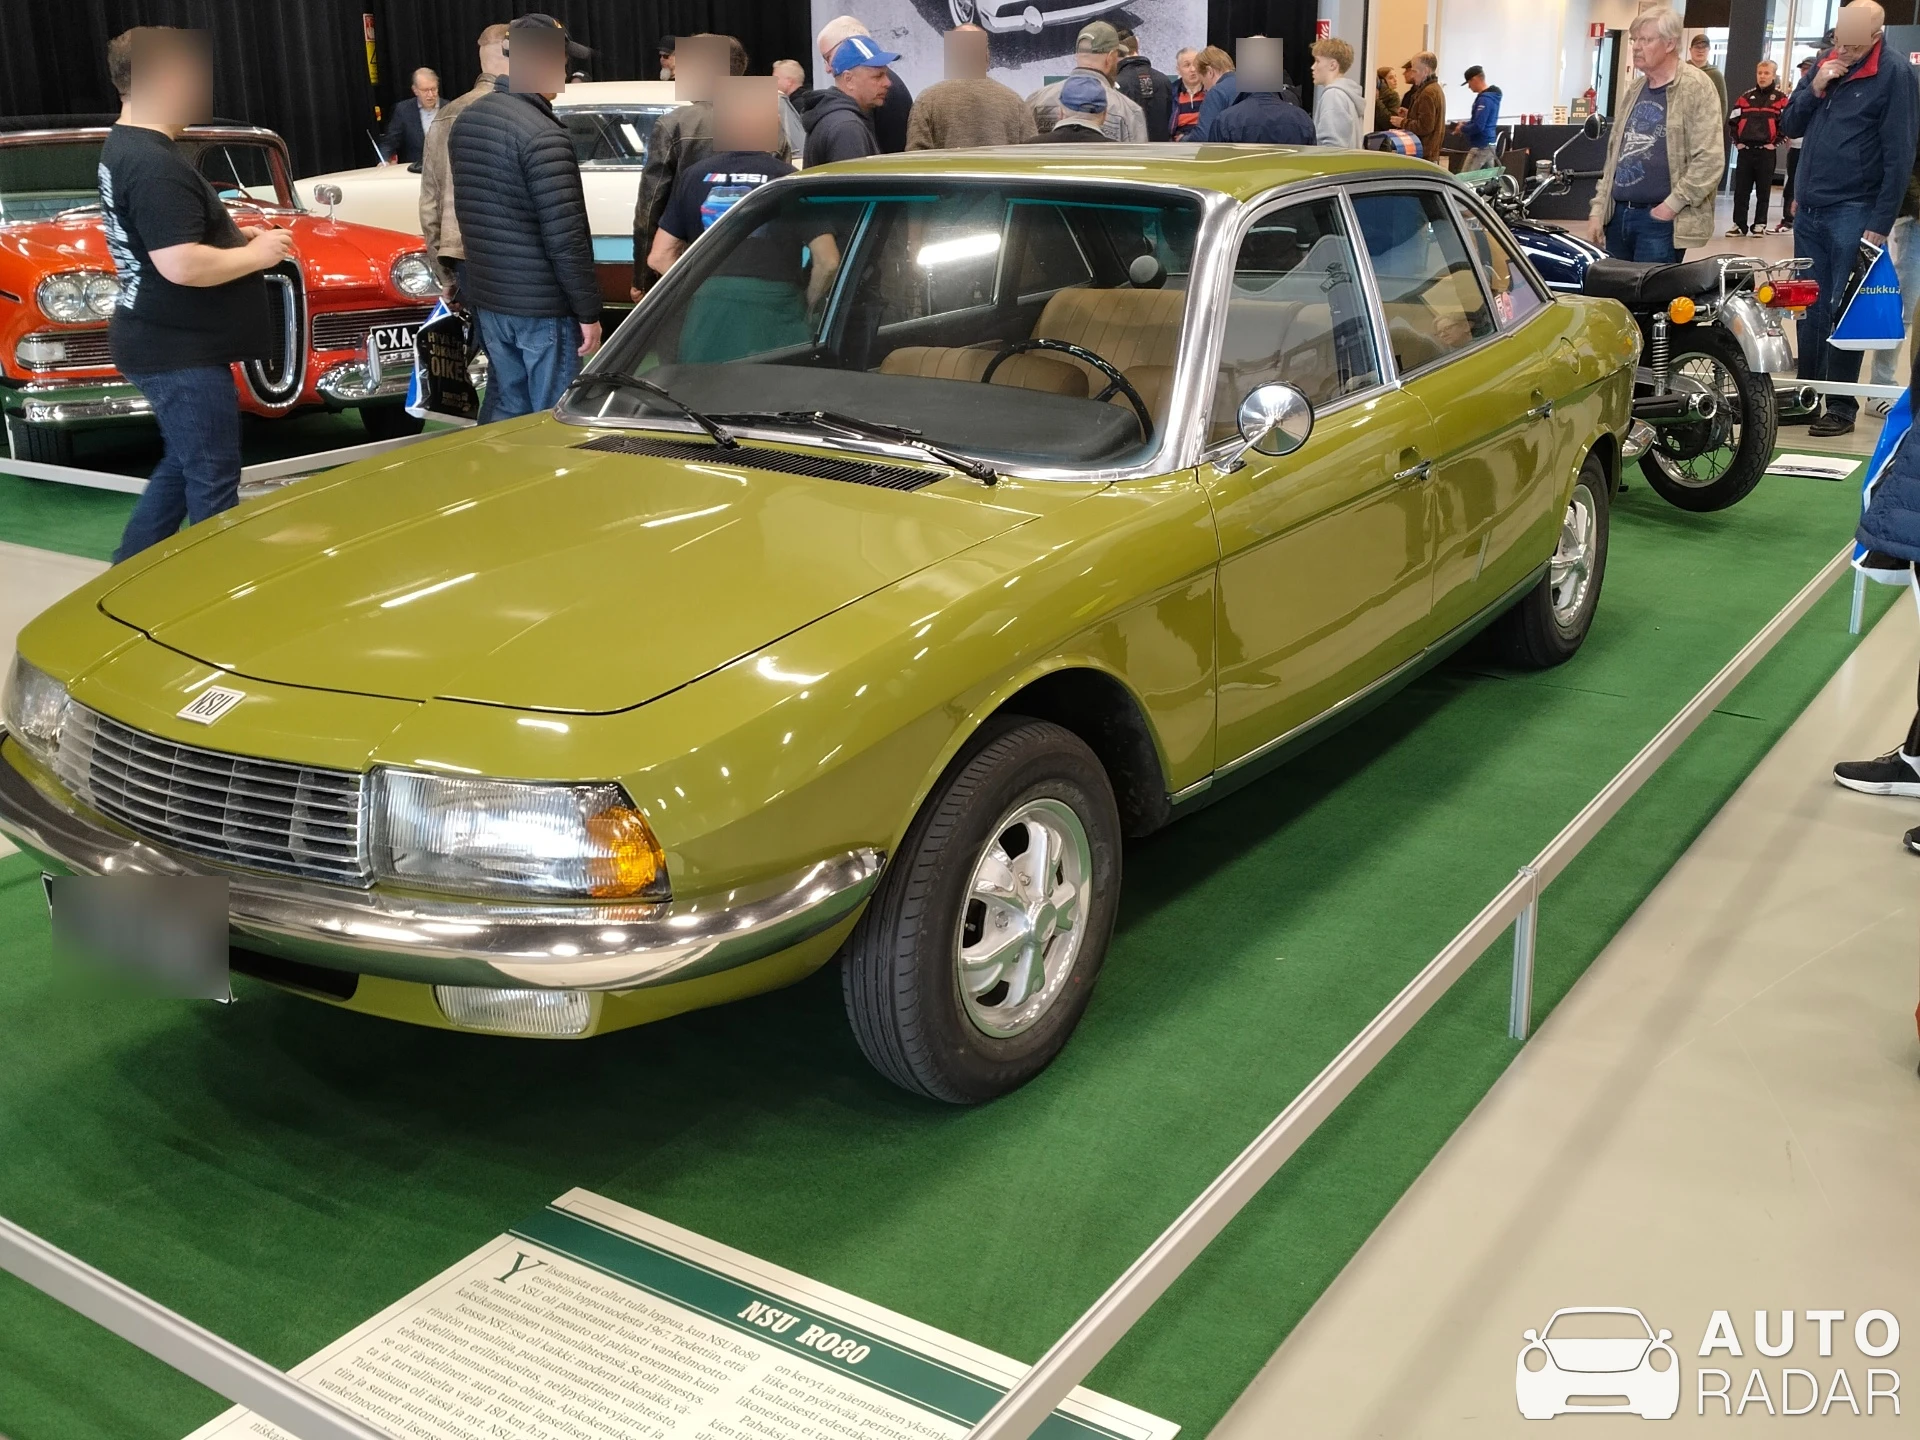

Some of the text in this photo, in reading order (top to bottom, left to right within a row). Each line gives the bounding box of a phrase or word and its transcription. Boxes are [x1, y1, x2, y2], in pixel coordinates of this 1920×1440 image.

[375, 327, 417, 350] CXA-
[186, 690, 235, 716] NSU
[455, 1286, 704, 1406] kaksikammioinen voimanlähteensä. Se oli ilmestys.
[455, 1302, 691, 1415] Isossa NSU:ssa oli kaikki: moderni ulkonäkö, vä-
[469, 1279, 720, 1395] riin, mutta uusi ihmeauto oli paljon enemmän kuin
[517, 1283, 732, 1381] NSU oli panostanut lujasti wankelmootto-
[531, 1275, 748, 1373] esiteltiin loppuvuodesta 1967. Tiedettiin, että
[590, 1285, 605, 1295] ei
[600, 1290, 627, 1305] ollut
[623, 1299, 649, 1315] tulla
[646, 1308, 684, 1332] loppua,
[684, 1324, 707, 1340] kun
[705, 1334, 734, 1350] NSU
[729, 1344, 761, 1362] Ro80
[737, 1300, 871, 1364] NSU RO80
[318, 1378, 405, 1426] wankelmoottorin
[334, 1367, 355, 1382] tiin
[351, 1376, 368, 1388] ja
[365, 1384, 403, 1405] suuret
[351, 1355, 411, 1390] Tulevaisuus
[409, 1386, 429, 1398] oli
[424, 1393, 457, 1413] tässä
[450, 1406, 465, 1418] ja
[463, 1414, 486, 1430] nyt.
[366, 1346, 548, 1439] ta ja turvalliselta vielä 180 km/h:n
[380, 1337, 396, 1347] se
[394, 1343, 414, 1355] oli
[409, 1349, 472, 1384] täydellinen:
[470, 1380, 498, 1396] auto
[497, 1392, 536, 1414] tuntui
[396, 1326, 449, 1355] tehostettu
[445, 1348, 557, 1408] hammastanko-ohjaus.
[411, 1316, 665, 1440] täydellinen erillisjousitus, nelipyörälevyjarrut ja
[426, 1307, 676, 1429] rinätön voimalinja, puoliautomaattinen vaihteisto,
[748, 1384, 822, 1421] kivaltaisesti
[761, 1373, 789, 1391] liike
[788, 1387, 806, 1399] on
[803, 1394, 860, 1424] pyörivää,
[774, 1365, 792, 1376] on
[790, 1369, 825, 1390] kevyt
[822, 1384, 837, 1395] ja
[835, 1391, 906, 1425] näennäisen
[707, 1418, 735, 1437] kien
[735, 1395, 801, 1431] likoneistoa
[801, 1427, 817, 1437] ei
